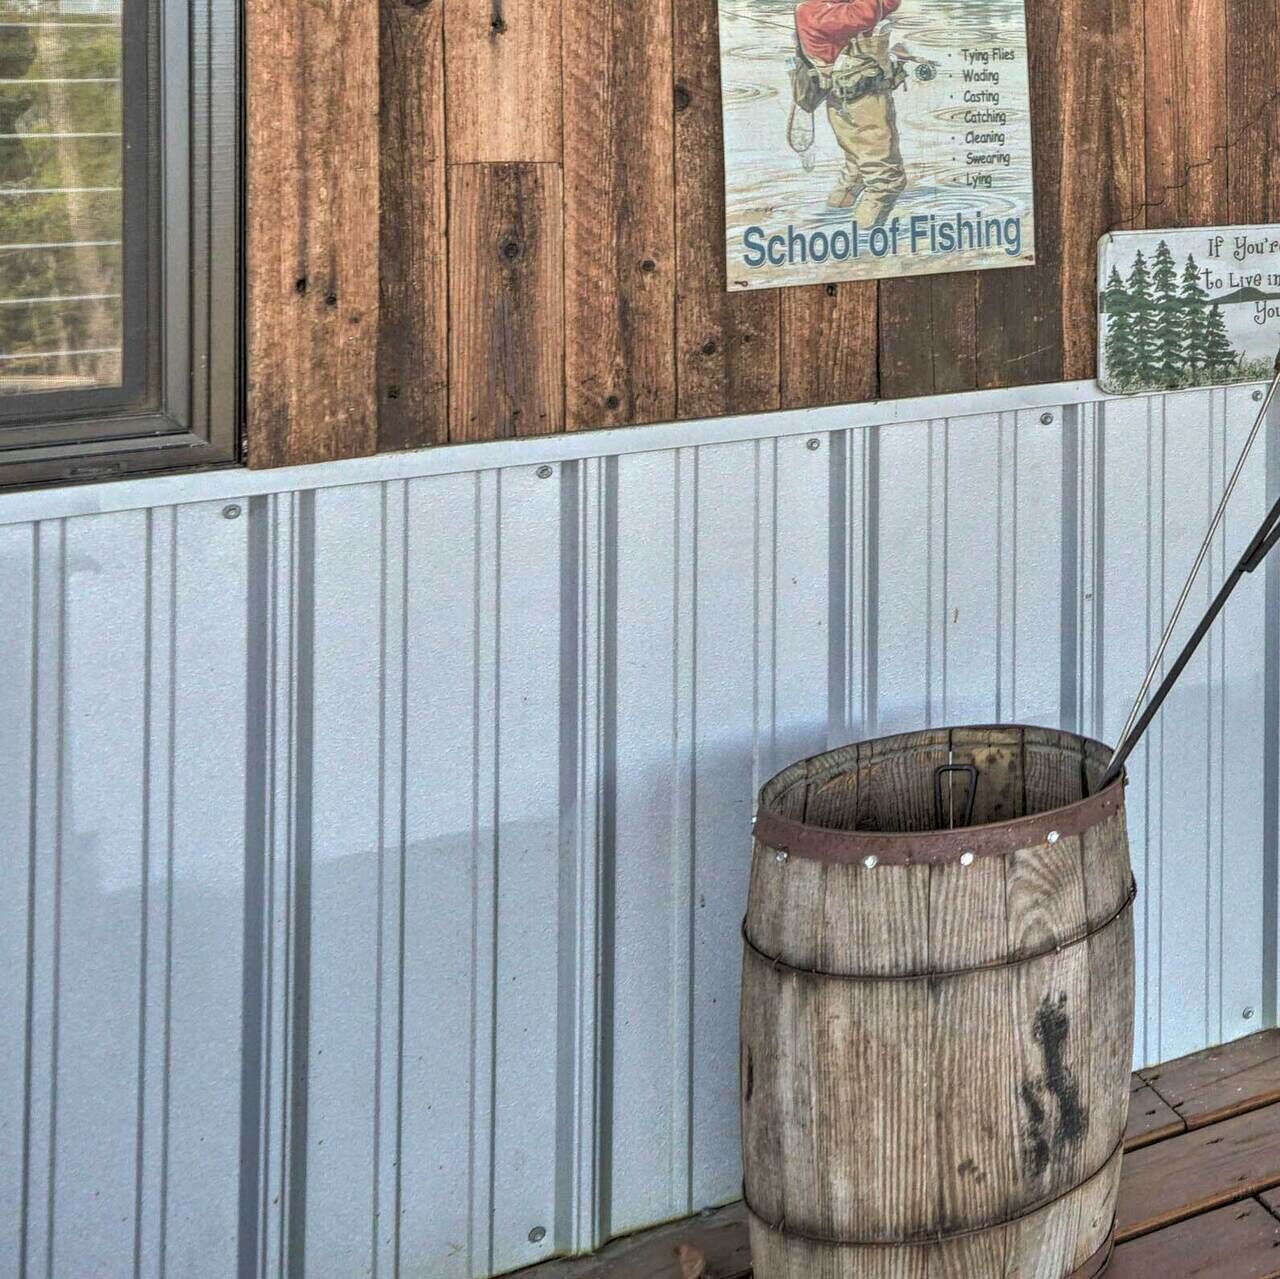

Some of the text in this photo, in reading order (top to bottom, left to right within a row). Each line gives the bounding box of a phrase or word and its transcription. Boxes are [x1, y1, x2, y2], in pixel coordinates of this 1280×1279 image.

[961, 47, 1015, 65] Tying Flies
[963, 69, 999, 85] Wading
[963, 90, 999, 105] Casting
[964, 109, 1006, 126] Catching
[965, 131, 1005, 146] Cleaning
[966, 151, 1010, 166] Swearing
[966, 172, 992, 189] Lying
[743, 210, 1021, 267] School of Fishing
[1208, 235, 1224, 257] If
[1200, 268, 1223, 289] to
[1228, 272, 1261, 288] Live
